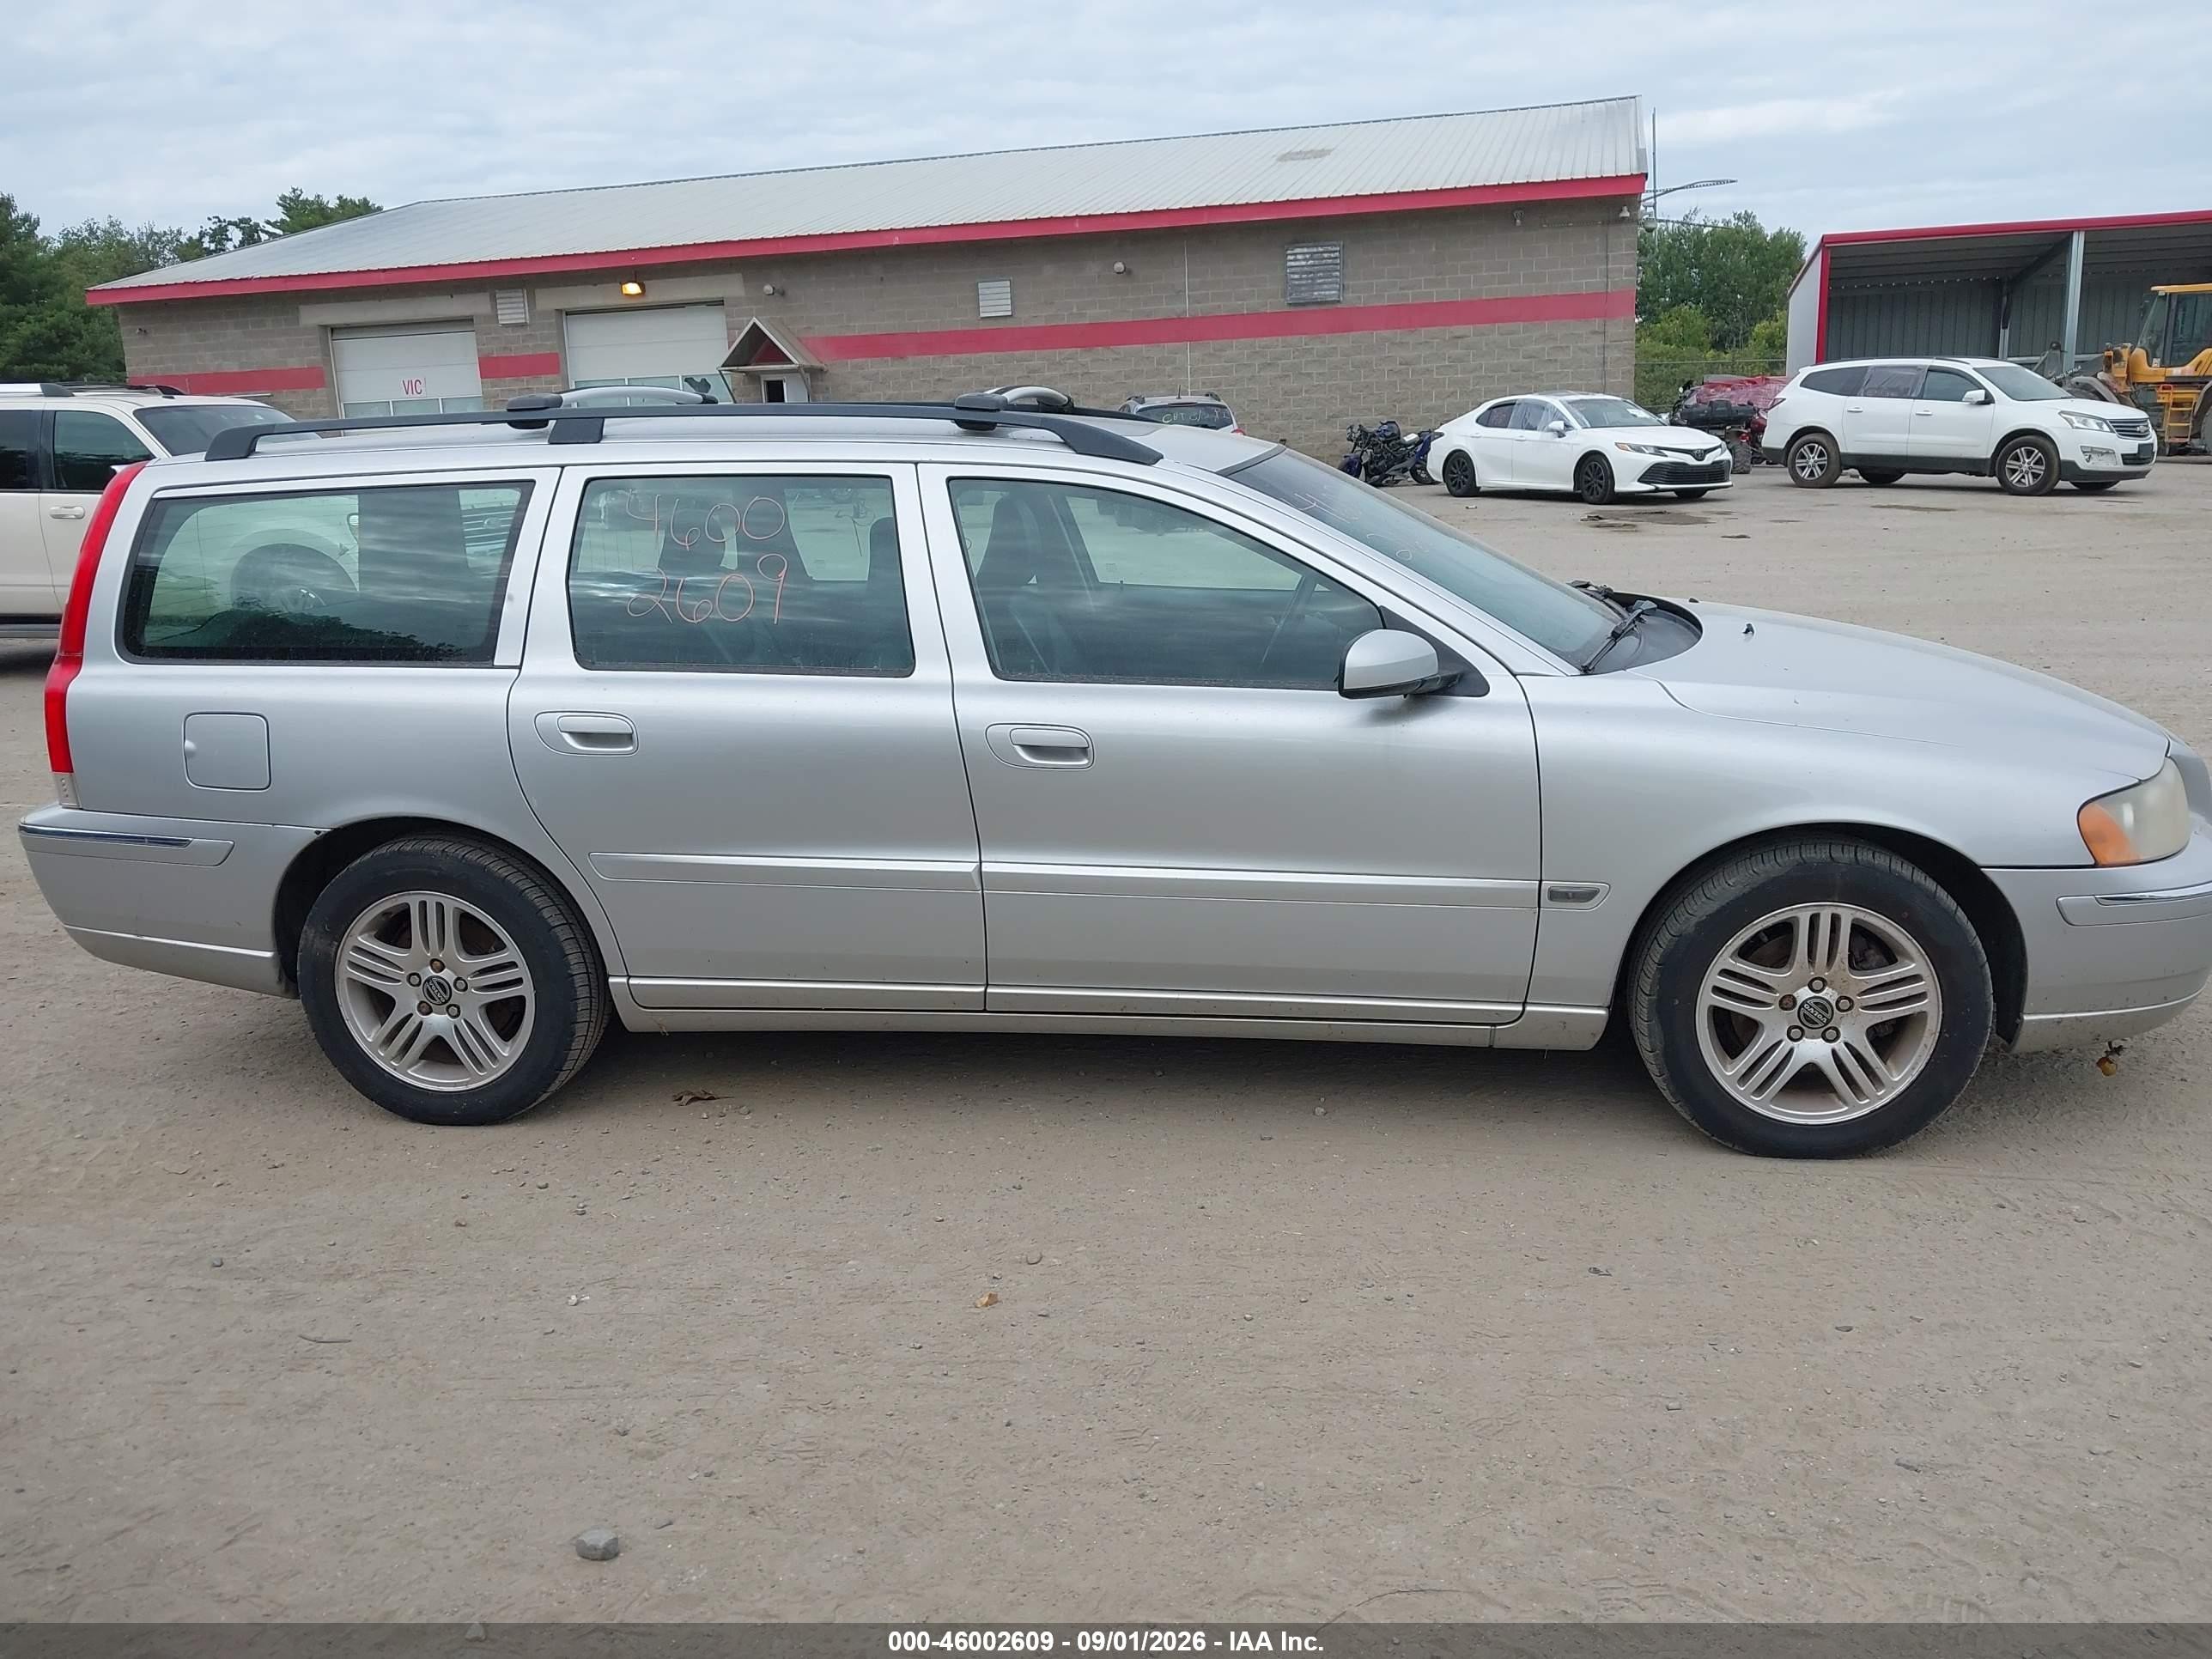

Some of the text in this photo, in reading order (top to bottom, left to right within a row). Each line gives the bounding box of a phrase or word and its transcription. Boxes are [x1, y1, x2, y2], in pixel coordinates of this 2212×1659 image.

[402, 379, 422, 395] VIC
[625, 489, 785, 551] 4600
[627, 553, 788, 625] 2609
[428, 980, 446, 1003] VOLVO
[1803, 1003, 1827, 1024] VOLVO
